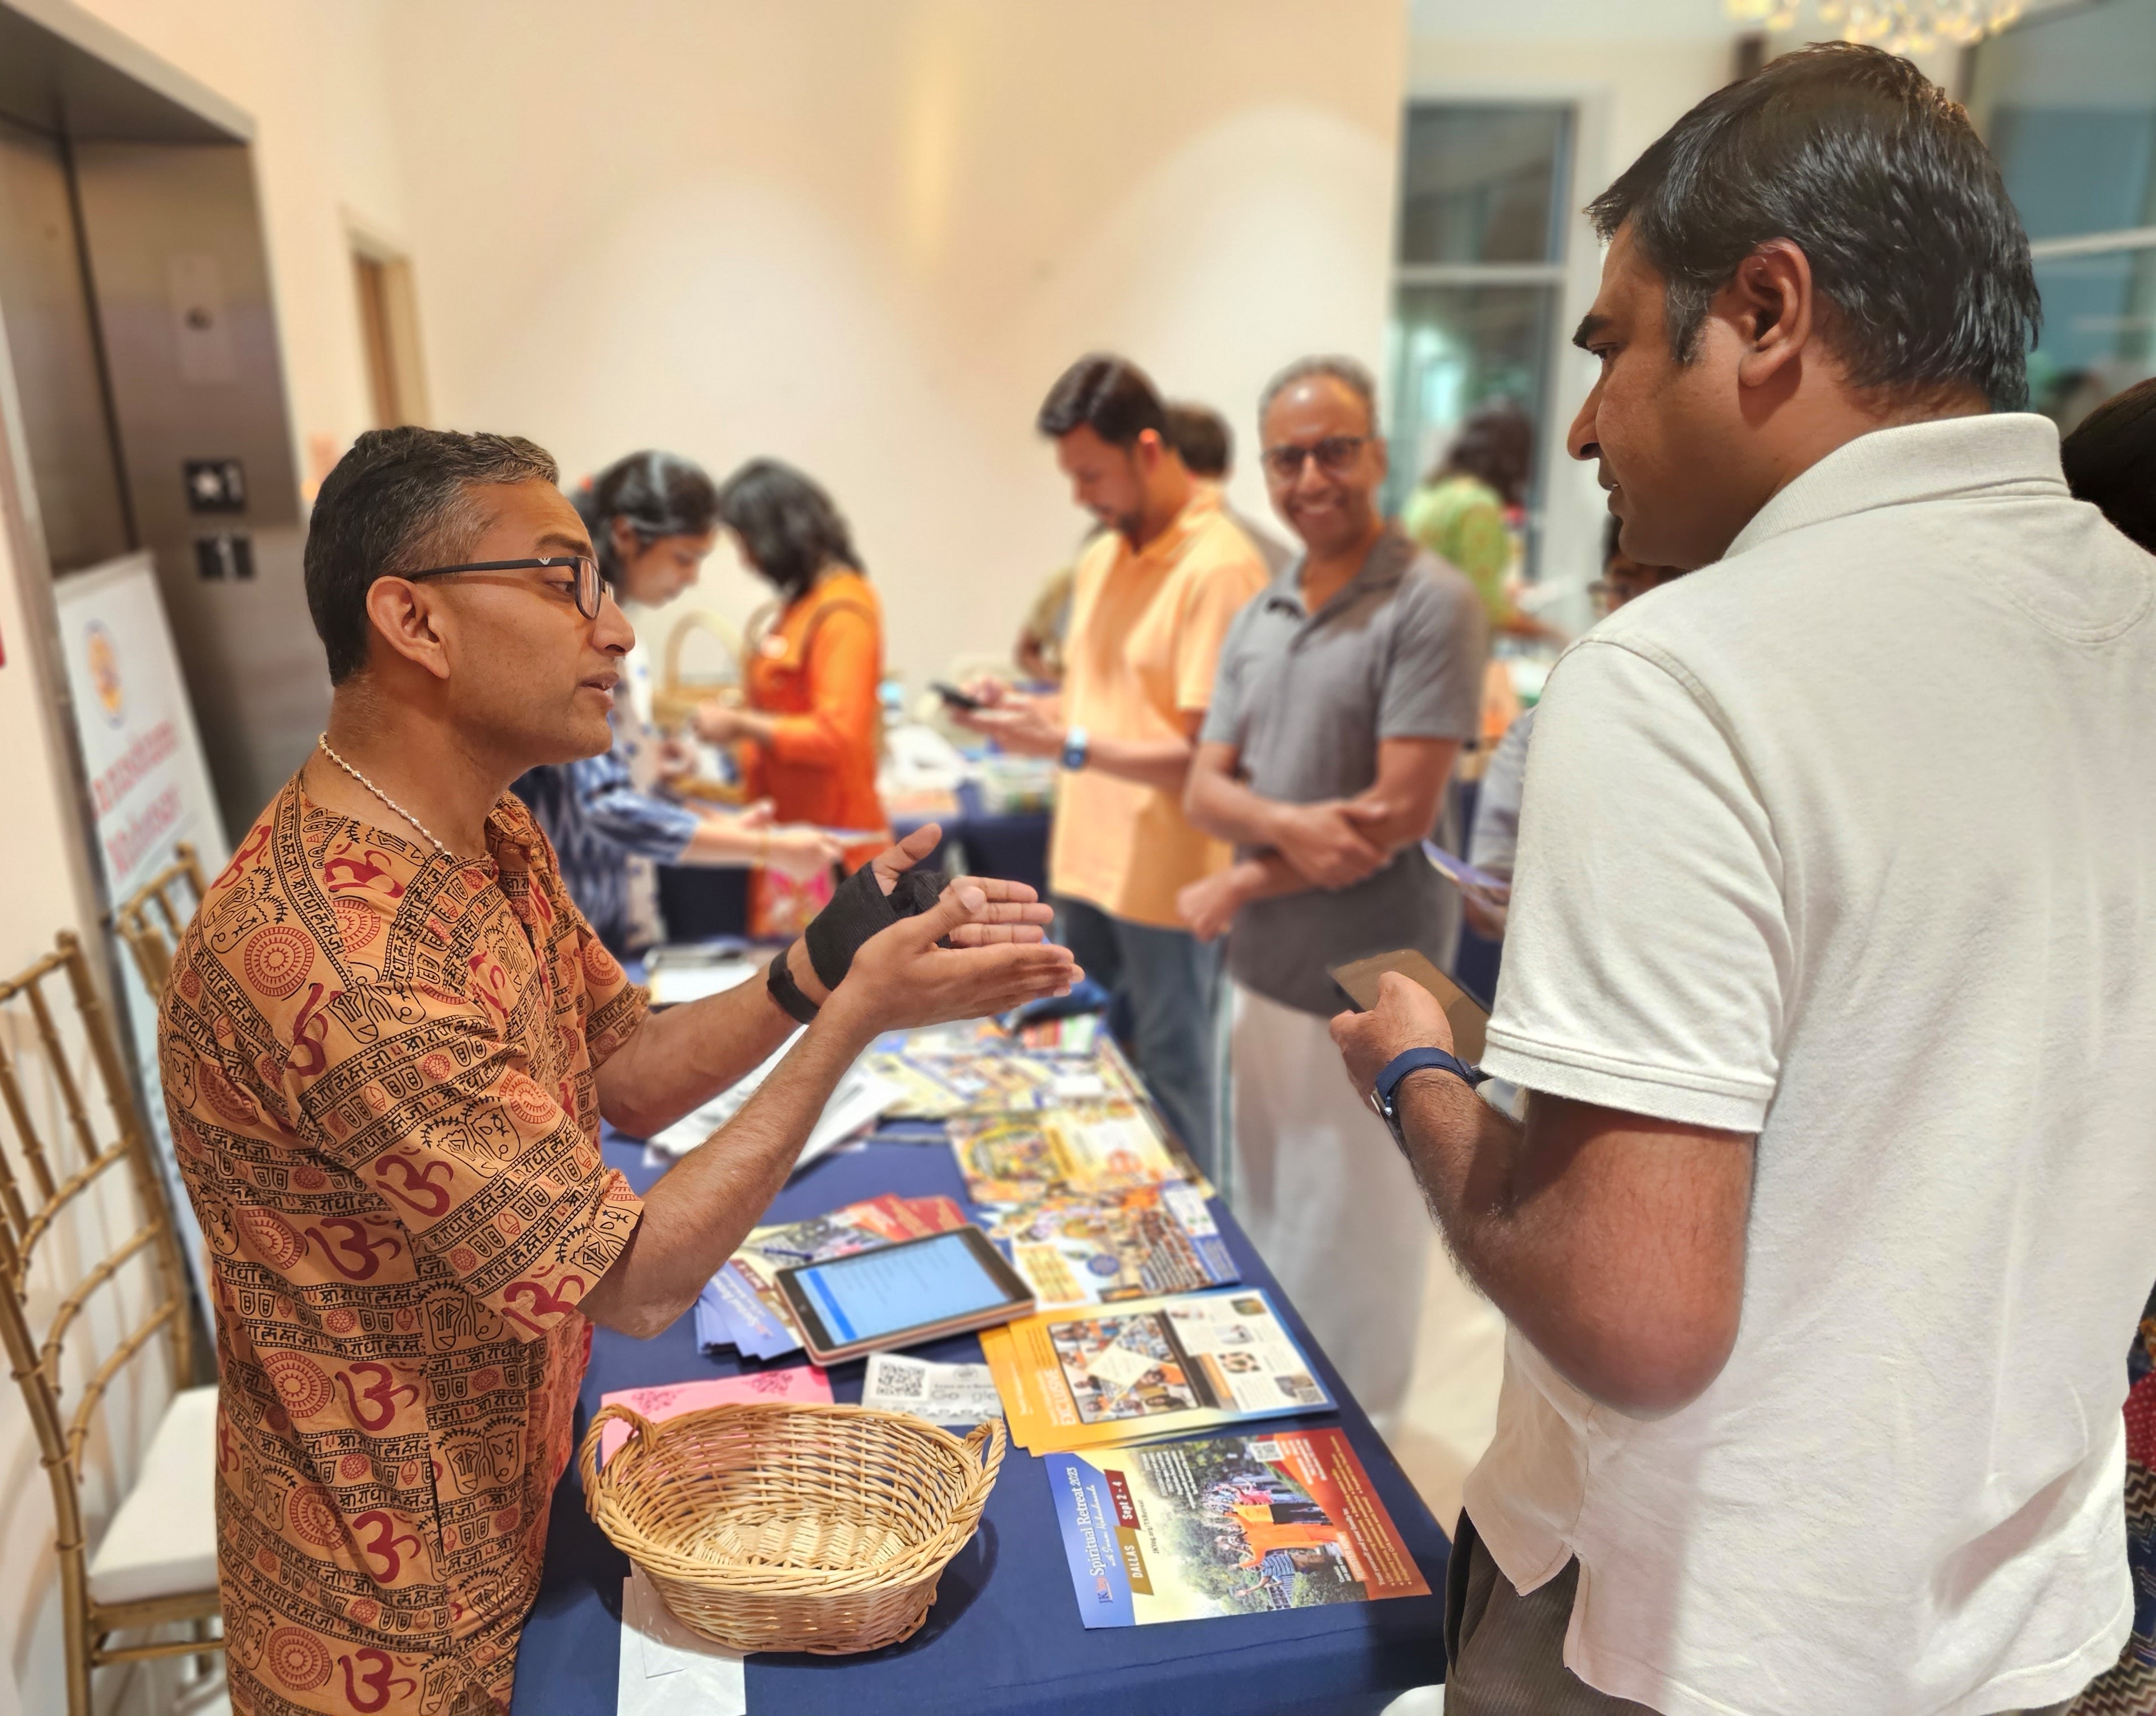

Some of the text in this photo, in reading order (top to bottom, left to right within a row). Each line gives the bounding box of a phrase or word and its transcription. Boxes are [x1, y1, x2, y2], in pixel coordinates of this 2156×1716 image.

[1066, 1467, 1081, 1485] 2023
[1072, 1487, 1091, 1524] Retreat
[1118, 1502, 1133, 1519] Sept
[1081, 1528, 1105, 1575] Spiritual
[1126, 1546, 1143, 1578] DALLAS
